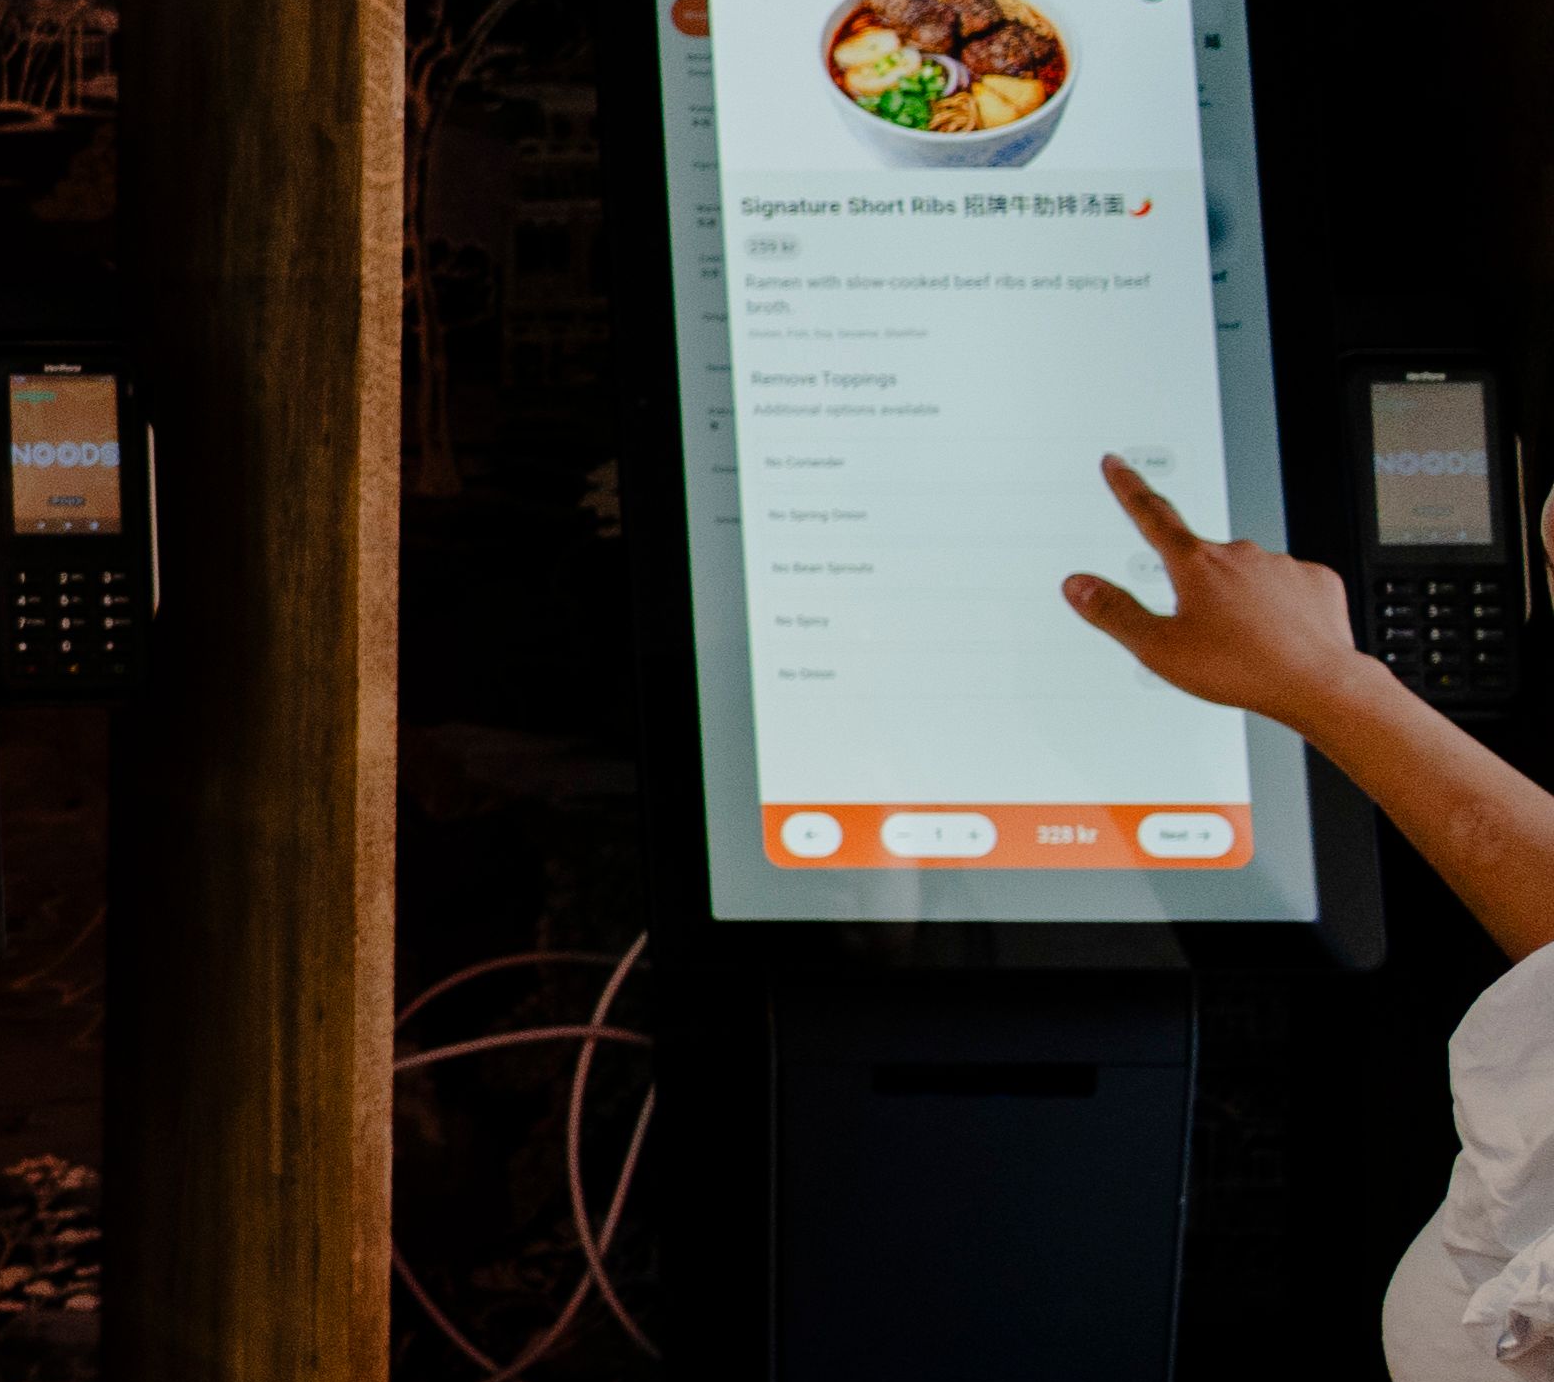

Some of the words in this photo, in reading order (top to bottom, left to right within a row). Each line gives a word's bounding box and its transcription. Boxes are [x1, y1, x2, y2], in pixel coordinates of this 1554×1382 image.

[741, 196, 841, 219] Signature
[848, 196, 905, 215] Short
[911, 196, 957, 215] Ribs
[745, 274, 802, 290] Ramen
[807, 274, 841, 290] with
[954, 273, 990, 289] beef
[995, 273, 1025, 289] ribs
[1031, 273, 1061, 289] and
[1066, 273, 1109, 293] spicy
[1114, 272, 1151, 289] beef
[749, 371, 818, 387] Remove
[822, 371, 898, 389] Toppings
[12, 441, 119, 467] NOODS
